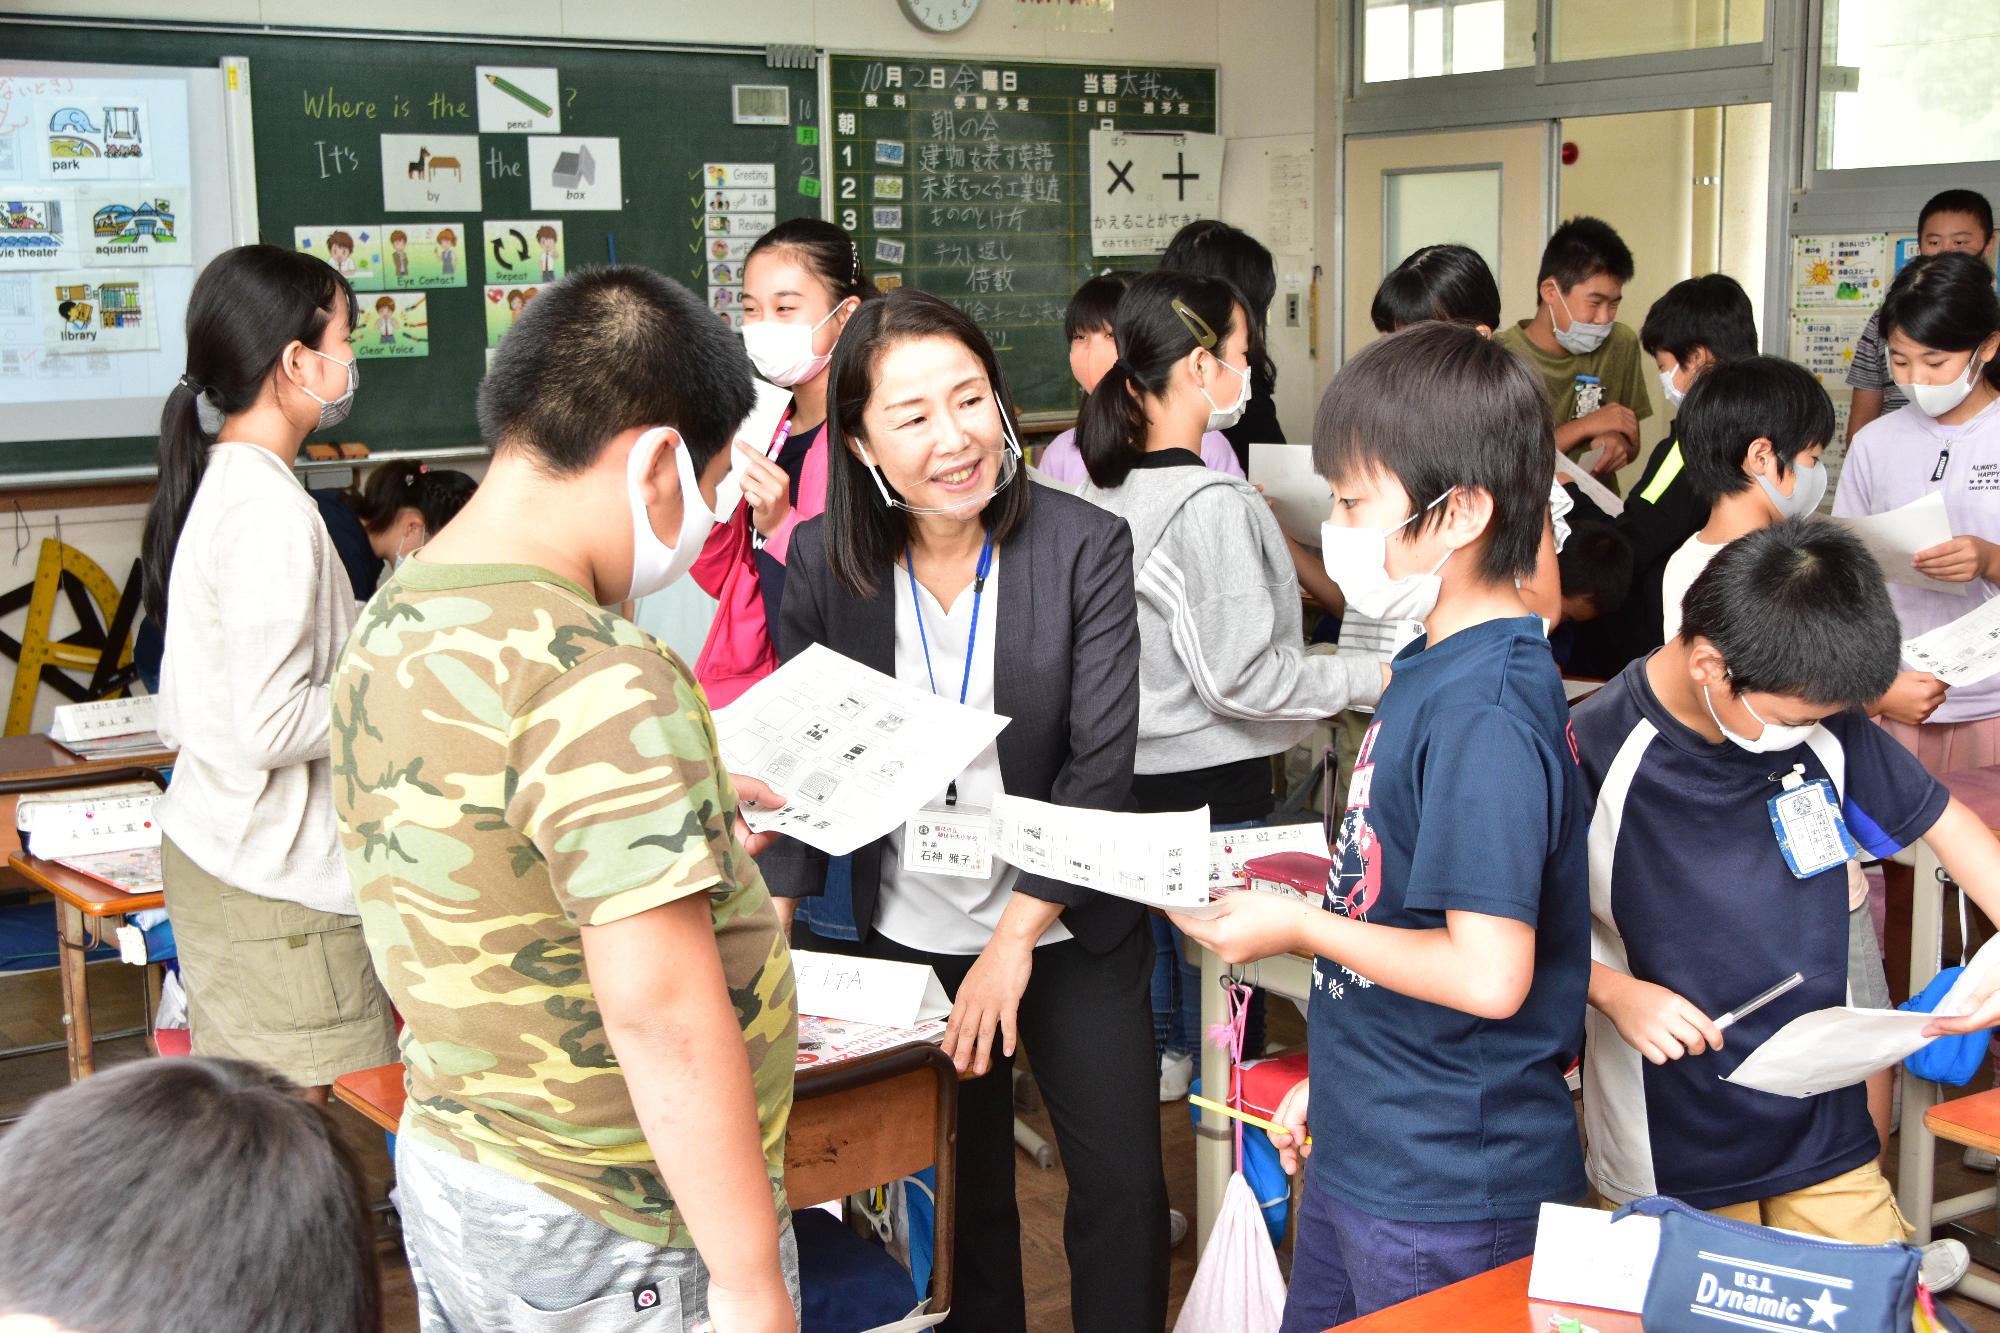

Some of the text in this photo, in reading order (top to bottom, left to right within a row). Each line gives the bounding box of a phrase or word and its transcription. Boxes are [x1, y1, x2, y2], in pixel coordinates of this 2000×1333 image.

[304, 87, 577, 119] Where is the ?
[507, 119, 533, 129] pencil
[838, 113, 855, 135] 朝
[930, 111, 999, 142] 朝の会
[314, 140, 522, 179] It's the
[842, 145, 852, 166] 1
[919, 142, 1055, 173] 建物を表す英語
[52, 160, 80, 172] park
[801, 157, 815, 175] 2
[733, 168, 769, 182] Greeting
[566, 189, 586, 200] box
[841, 177, 856, 198] 2
[427, 190, 440, 203] by
[738, 219, 768, 231] Review
[842, 208, 857, 231] 3
[18, 248, 58, 257] theater
[96, 245, 149, 255] aquarium
[933, 240, 1013, 267] テスト返し
[397, 275, 455, 288] Eye Contact
[496, 272, 529, 281] Repeat
[966, 266, 1016, 293] 倍数
[60, 331, 97, 342] library
[359, 346, 415, 355] Clear Voice
[1972, 463, 1997, 471] ALWAYS
[921, 850, 971, 864] 石神 雅子
[1734, 1271, 1774, 1294] U.S.A.
[1695, 1272, 1802, 1321] Dynamic
